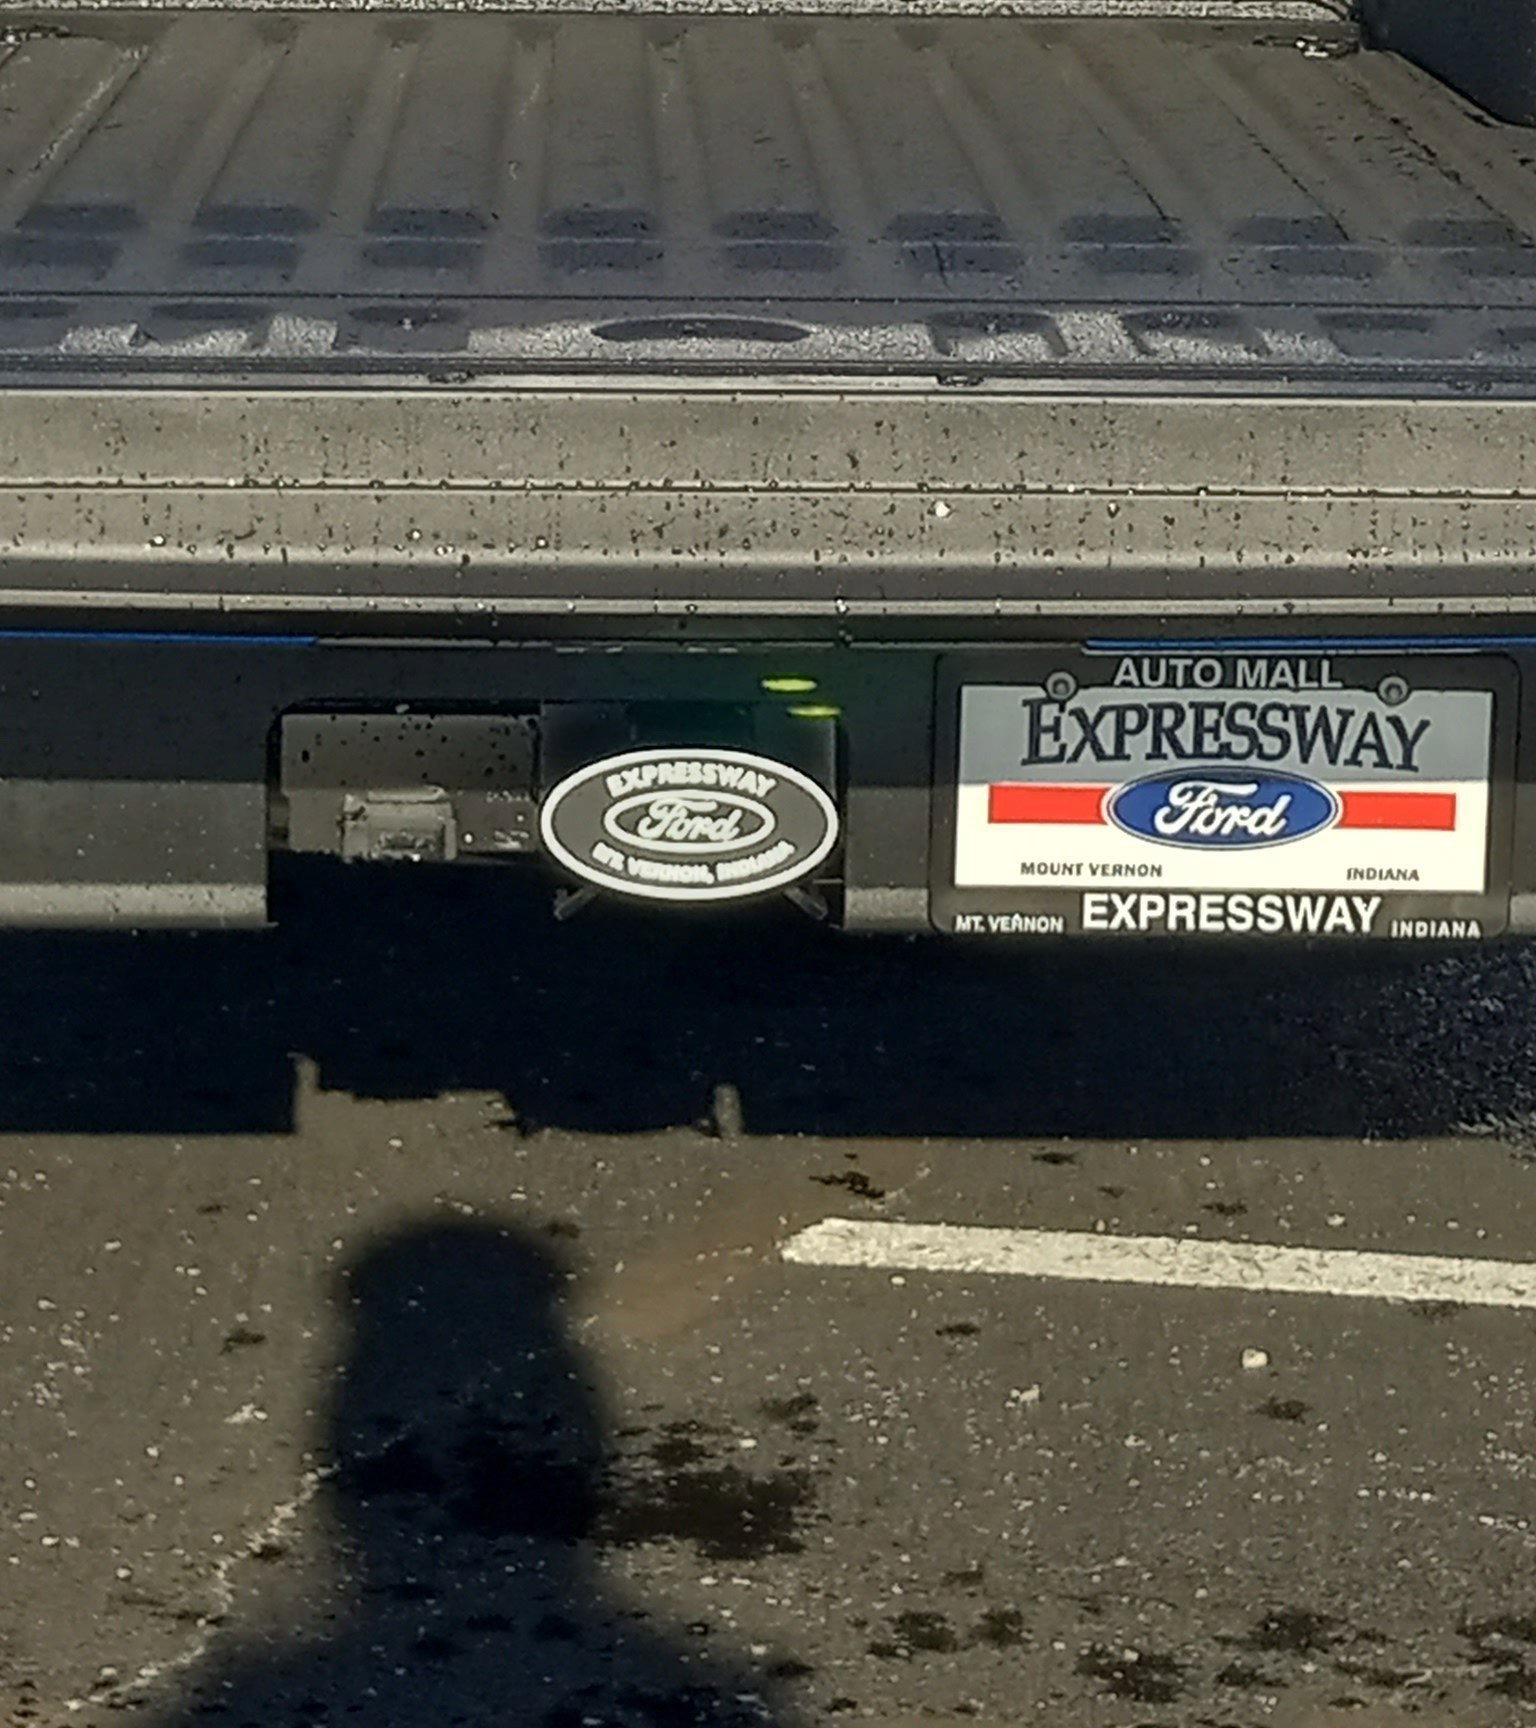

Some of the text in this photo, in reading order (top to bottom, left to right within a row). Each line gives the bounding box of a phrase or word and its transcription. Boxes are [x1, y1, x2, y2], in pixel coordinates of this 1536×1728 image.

[1113, 657, 1344, 689] AUTO MALL
[1020, 696, 1432, 773] EXPRESSWAY
[605, 760, 777, 798] EXPRESSWAY
[637, 798, 743, 841] Ford
[1154, 780, 1293, 836] Ford
[1020, 861, 1163, 878] MOUNT VERNON
[1346, 867, 1420, 882] INDIANA
[955, 892, 1482, 940] MT. VERNON EXPRESSWAY INDIANA
